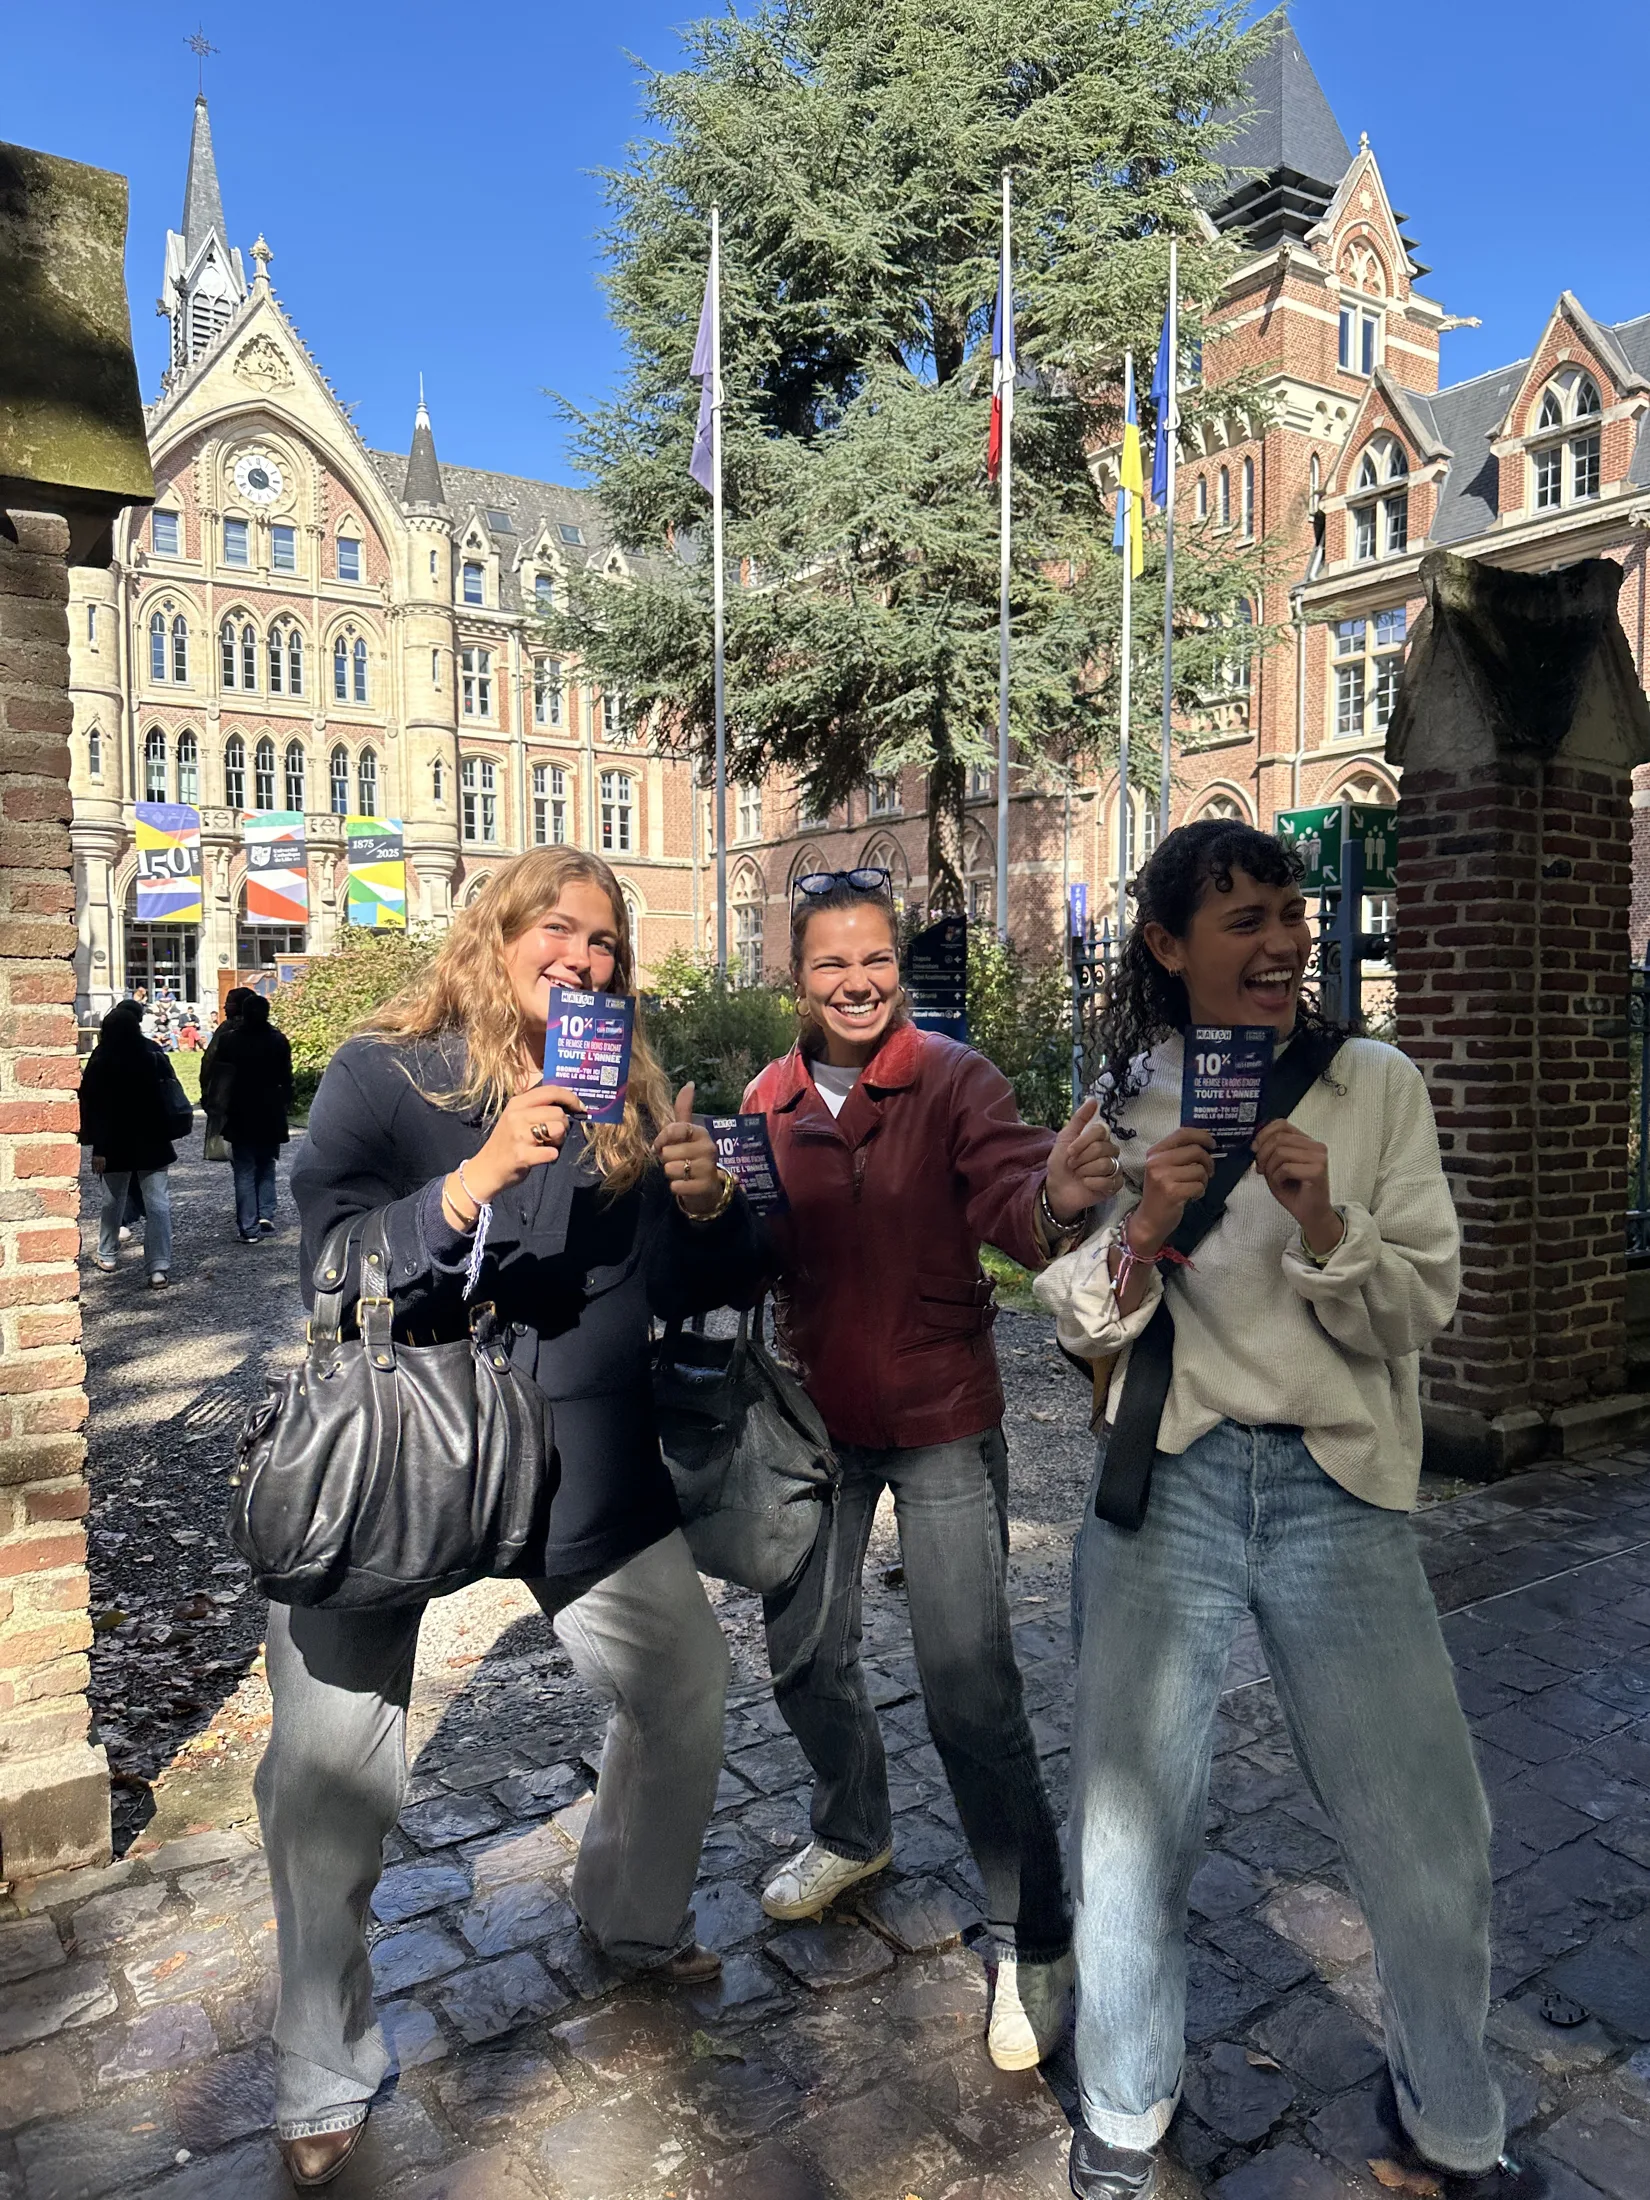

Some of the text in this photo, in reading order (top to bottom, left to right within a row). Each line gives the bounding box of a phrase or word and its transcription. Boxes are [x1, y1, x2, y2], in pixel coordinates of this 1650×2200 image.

[353, 839, 374, 849] 1875
[376, 848, 399, 858] 2025
[137, 847, 191, 880] 150
[561, 993, 594, 1006] MATCH
[560, 1015, 593, 1038] 10%
[1196, 1030, 1232, 1041] MATCH
[558, 1050, 586, 1061] TOUTE
[1195, 1053, 1231, 1075] 10%
[1194, 1090, 1225, 1099] TOUTE
[712, 1119, 737, 1129] MATCH
[716, 1137, 740, 1156] 10%
